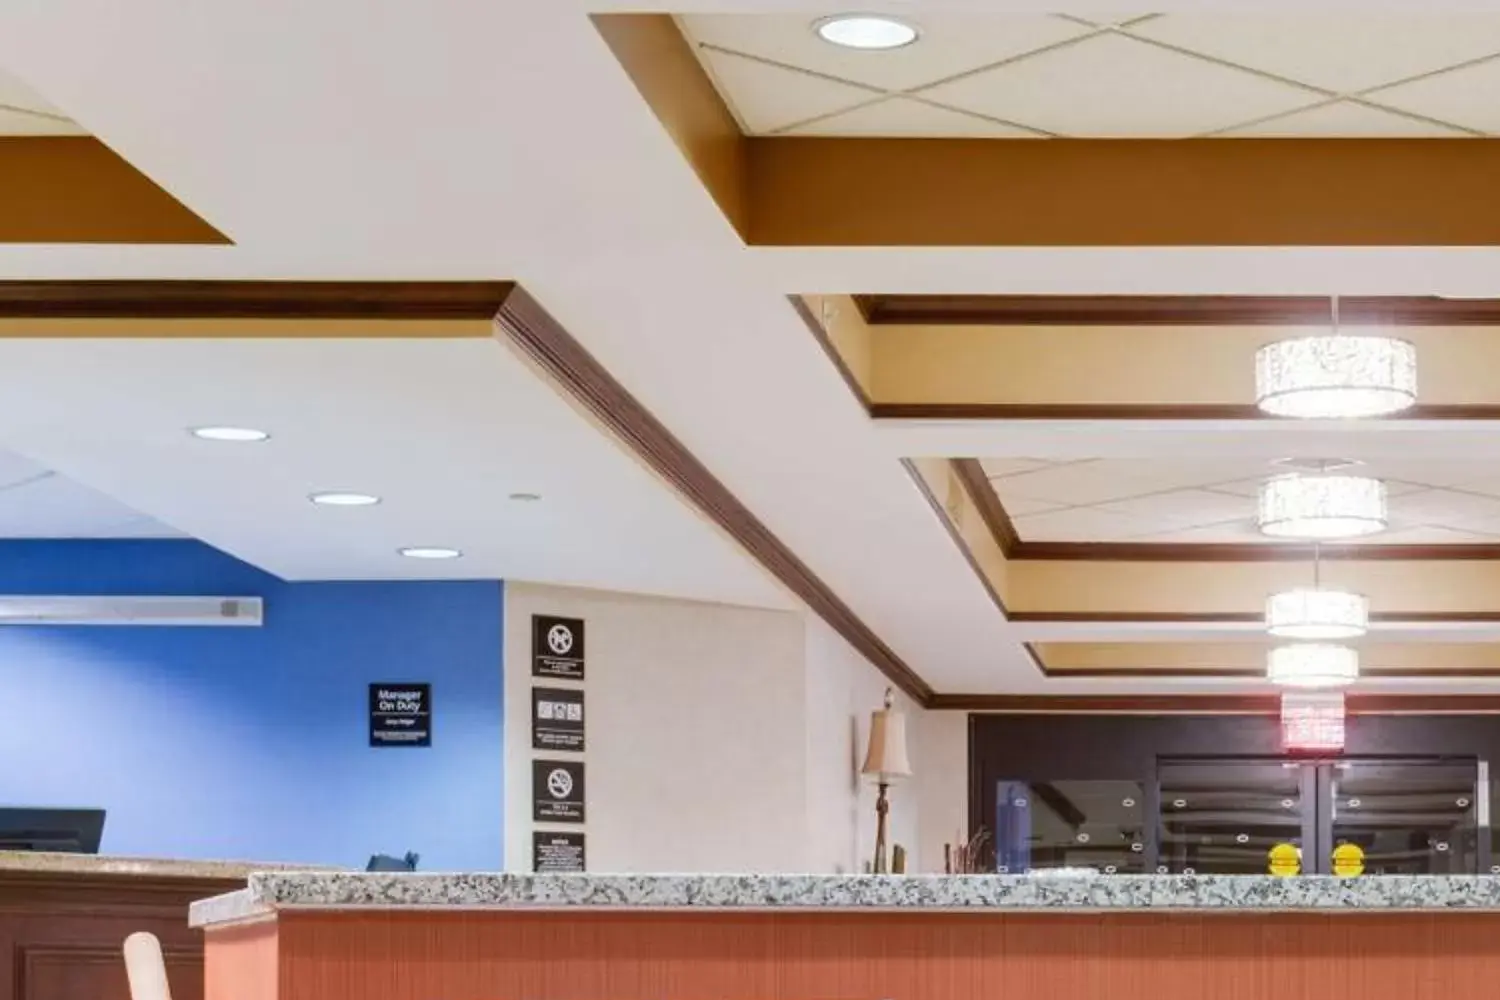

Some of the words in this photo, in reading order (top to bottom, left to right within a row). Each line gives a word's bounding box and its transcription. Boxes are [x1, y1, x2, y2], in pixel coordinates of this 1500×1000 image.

[379, 690, 421, 701] Manager
[379, 701, 394, 711] On
[397, 701, 420, 713] Duty
